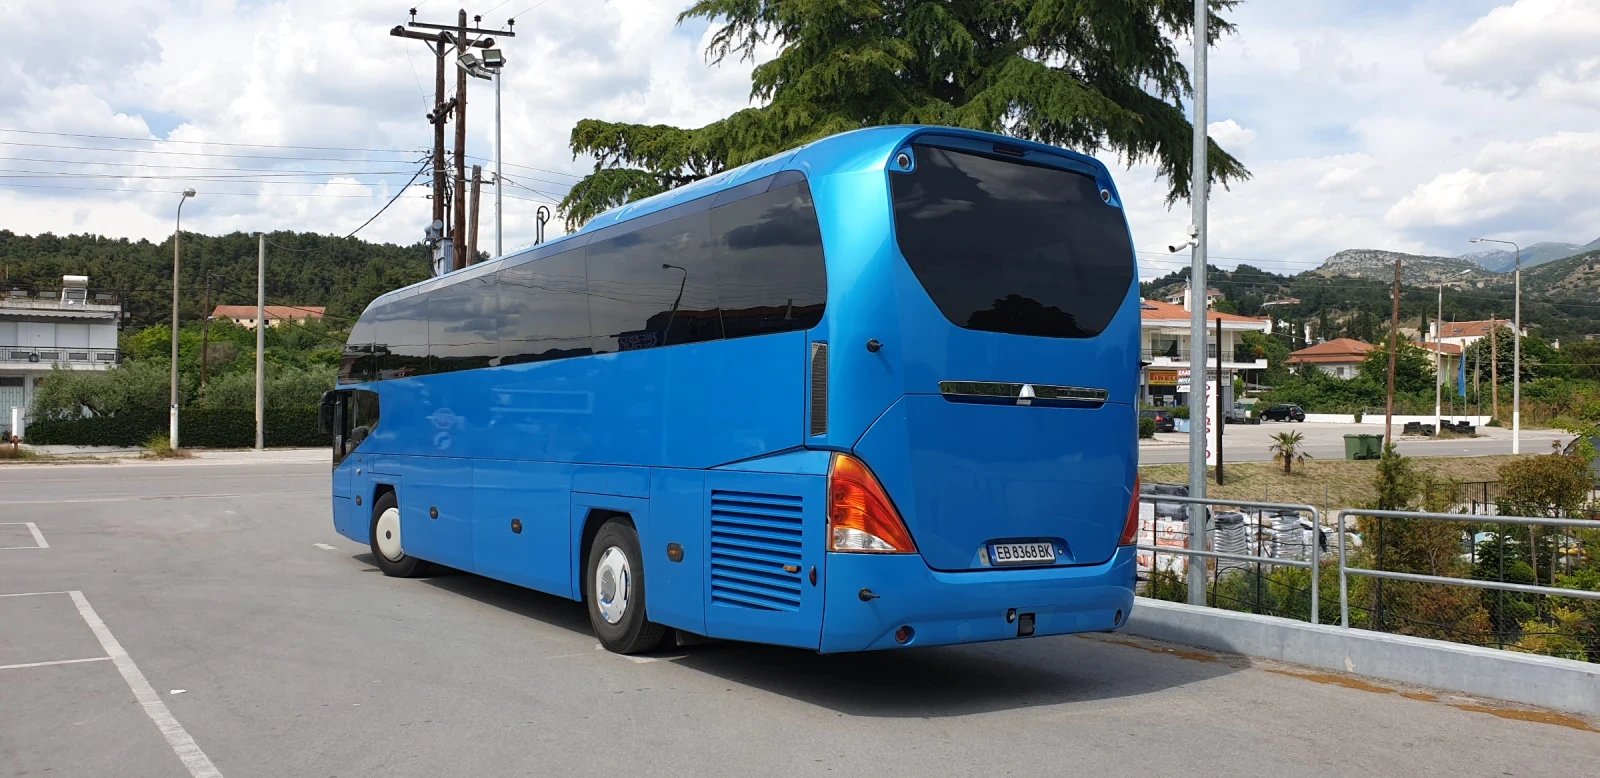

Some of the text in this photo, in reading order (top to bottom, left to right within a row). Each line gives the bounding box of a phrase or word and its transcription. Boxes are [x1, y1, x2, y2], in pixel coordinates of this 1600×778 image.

[997, 544, 1052, 559] EB 8368 BK
